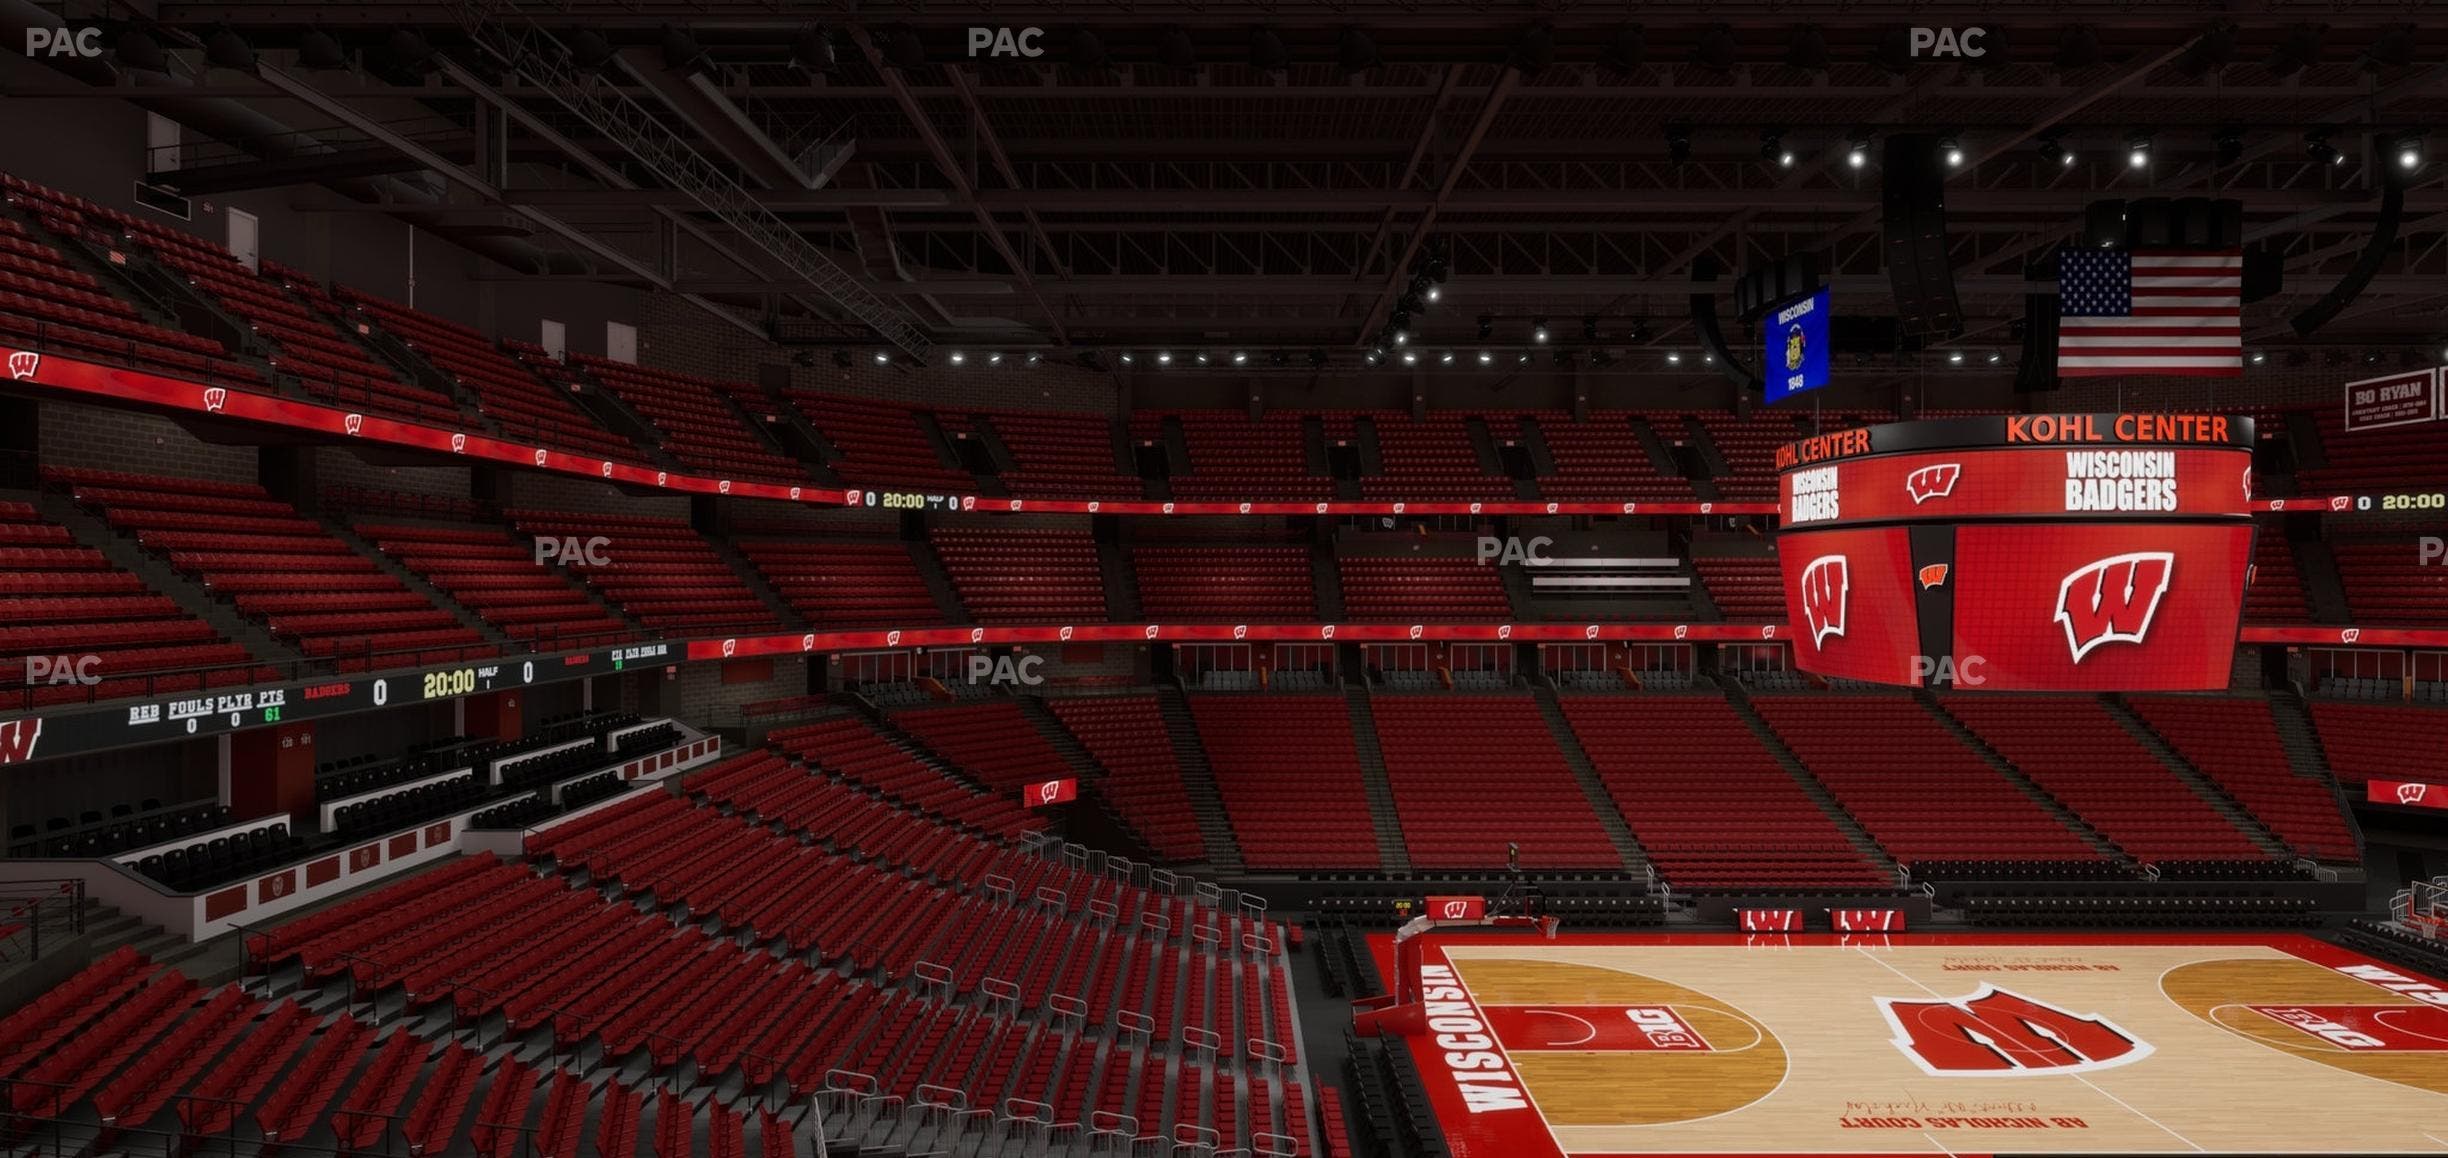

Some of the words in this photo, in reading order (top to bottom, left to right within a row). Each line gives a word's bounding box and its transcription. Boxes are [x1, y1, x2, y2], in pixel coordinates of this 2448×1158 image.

[2355, 389, 2376, 405] BO
[2380, 382, 2422, 402] RYAN
[2007, 415, 2103, 442] KOHL
[2114, 415, 2229, 442] CENTER
[1802, 428, 1870, 461] CENTER
[2066, 451, 2175, 478] WISCONSIN
[1906, 463, 1961, 504] W
[2065, 478, 2177, 511] BADGERS
[866, 492, 876, 506] 0
[883, 493, 924, 509] 20:00
[949, 496, 958, 510] 0
[2358, 496, 2371, 510] 0
[2383, 494, 2446, 510] 20:00
[2053, 552, 2174, 664] W
[374, 679, 387, 705] 0
[424, 669, 475, 698] 20:00
[478, 666, 498, 678] HALF
[524, 661, 534, 684] 0
[129, 704, 160, 722] REB
[168, 697, 214, 717] FOULS
[217, 692, 253, 711] PLYR
[258, 689, 285, 706] PTS
[186, 717, 197, 733] 0
[230, 712, 241, 727] 0
[264, 706, 281, 722] 61
[1421, 965, 1528, 1113] WISCONSIN
[1840, 1116, 1922, 1129] COURT
[1925, 1117, 2049, 1129] NICHOLAS
[2049, 1117, 2089, 1129] AB
